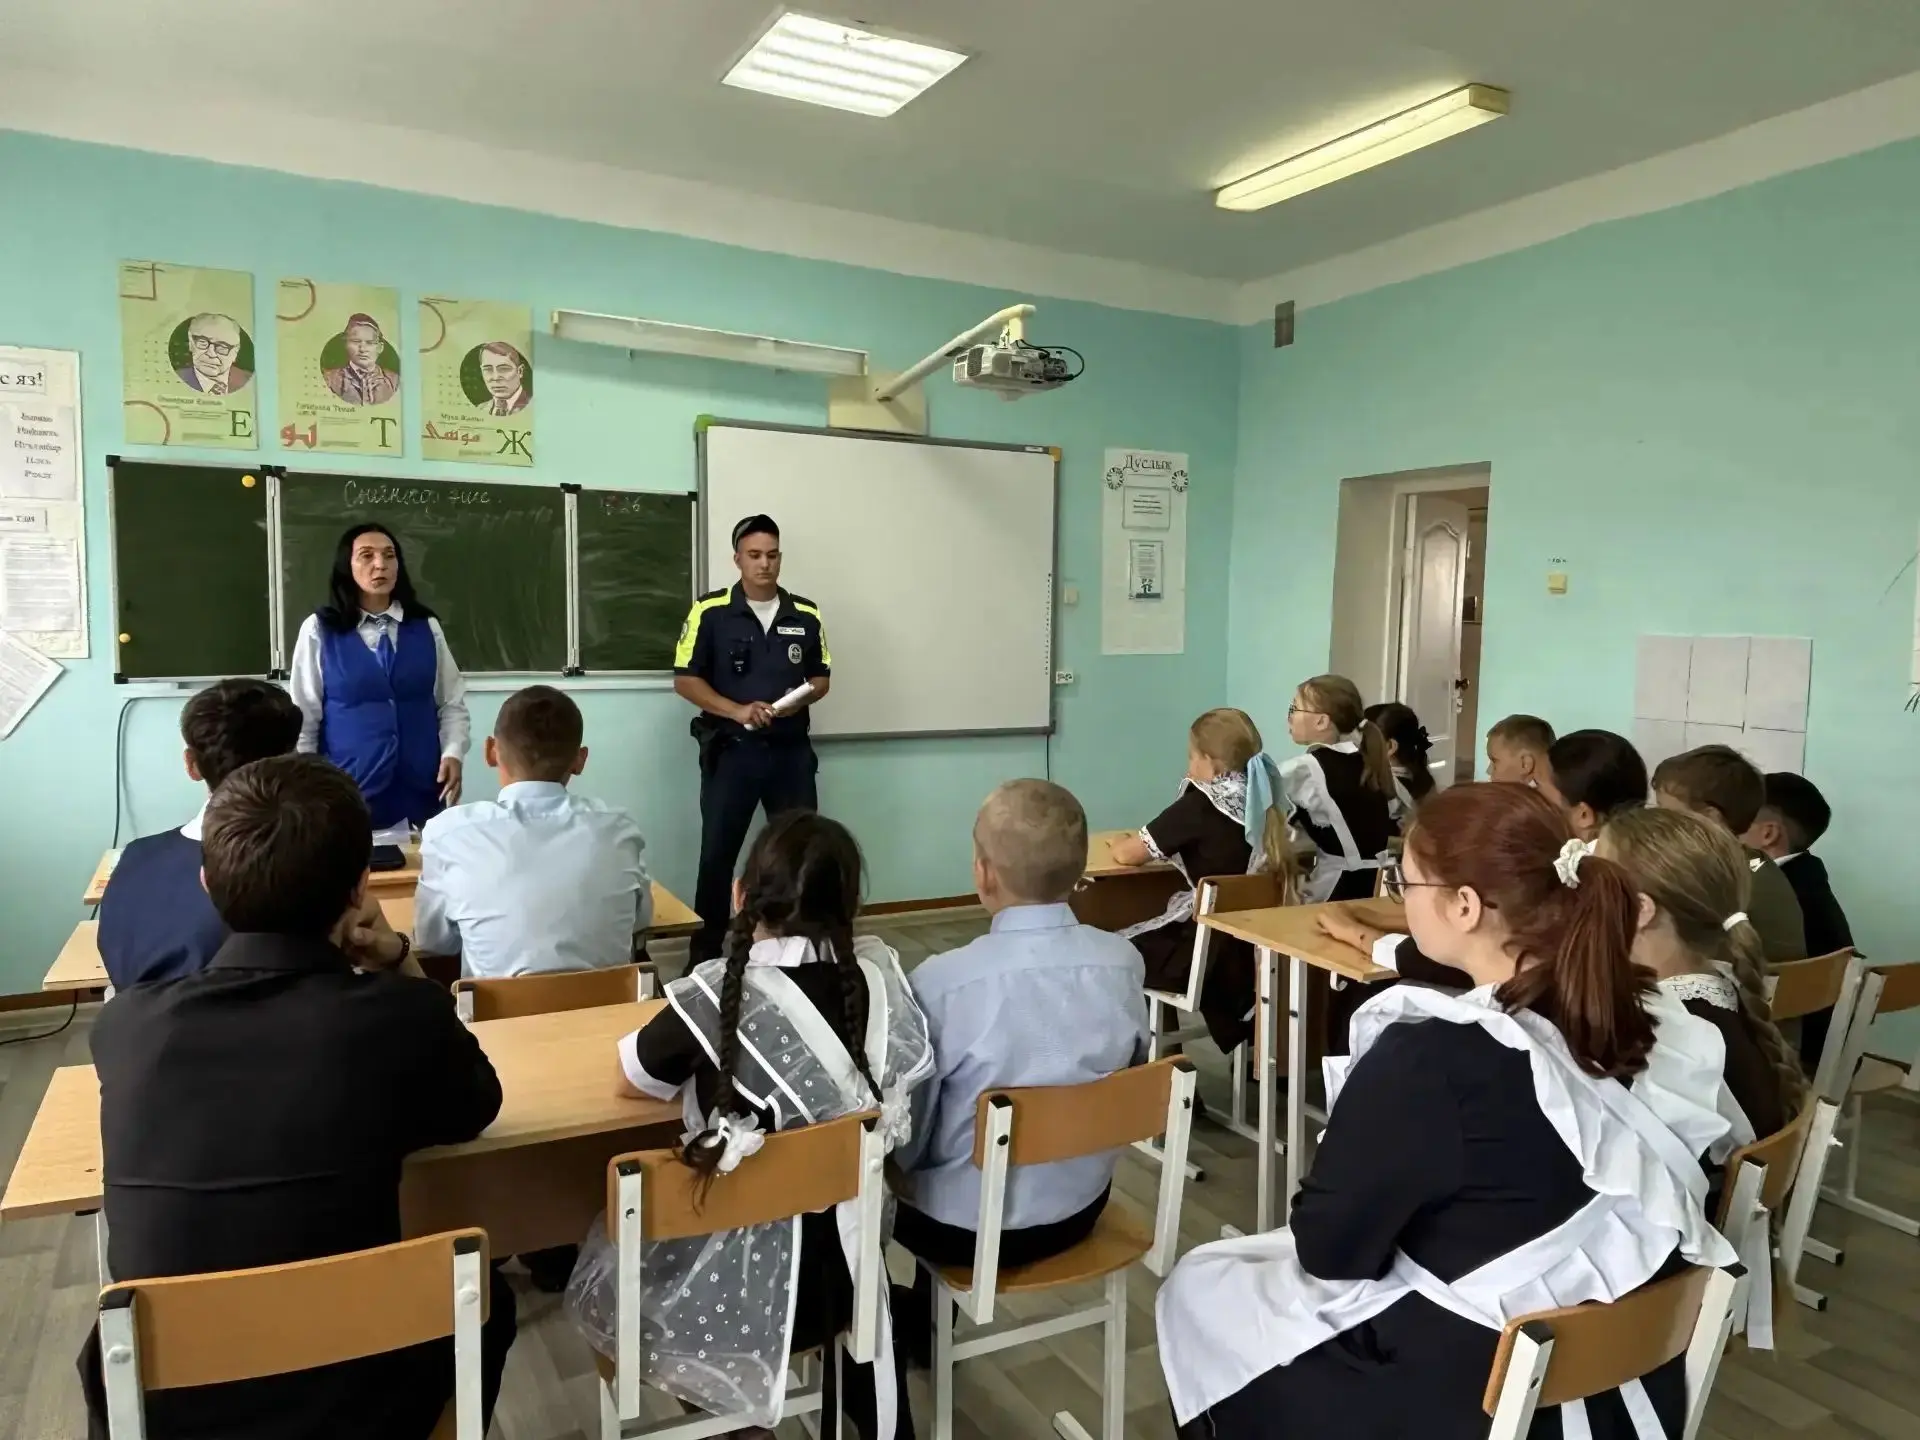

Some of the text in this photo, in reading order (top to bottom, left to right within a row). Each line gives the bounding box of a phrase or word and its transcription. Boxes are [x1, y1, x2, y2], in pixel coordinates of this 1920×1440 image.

[16, 371, 43, 387] яз!
[229, 409, 252, 437] Е
[369, 416, 397, 448] Т
[1122, 454, 1173, 472] Дуслык
